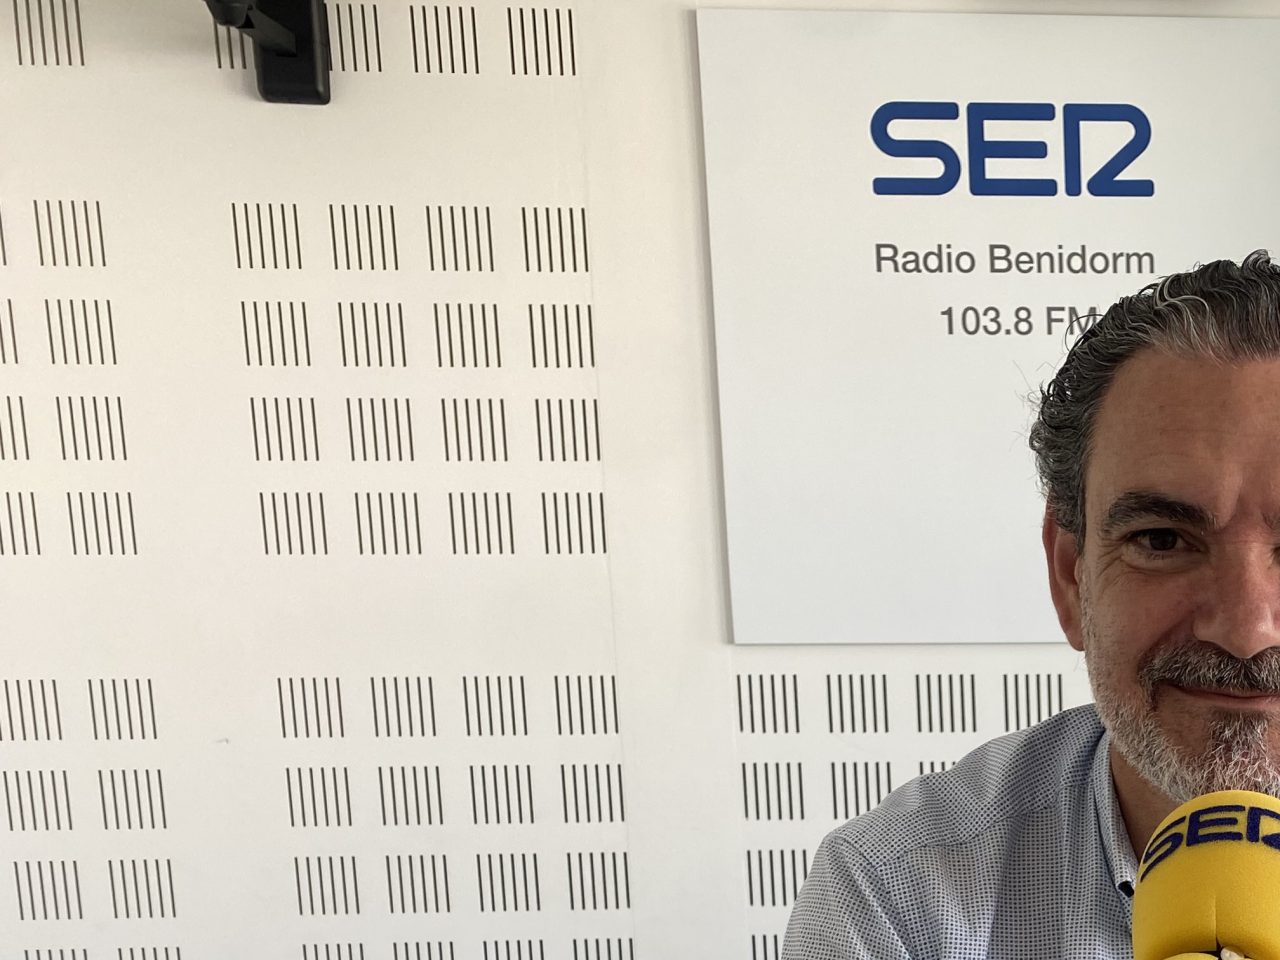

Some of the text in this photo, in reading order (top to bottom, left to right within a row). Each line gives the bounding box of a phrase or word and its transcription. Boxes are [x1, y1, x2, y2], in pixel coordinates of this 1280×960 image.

[870, 101, 1154, 197] SER
[874, 243, 1155, 274] Radio Benidorm
[940, 306, 1099, 336] 103.8 FM
